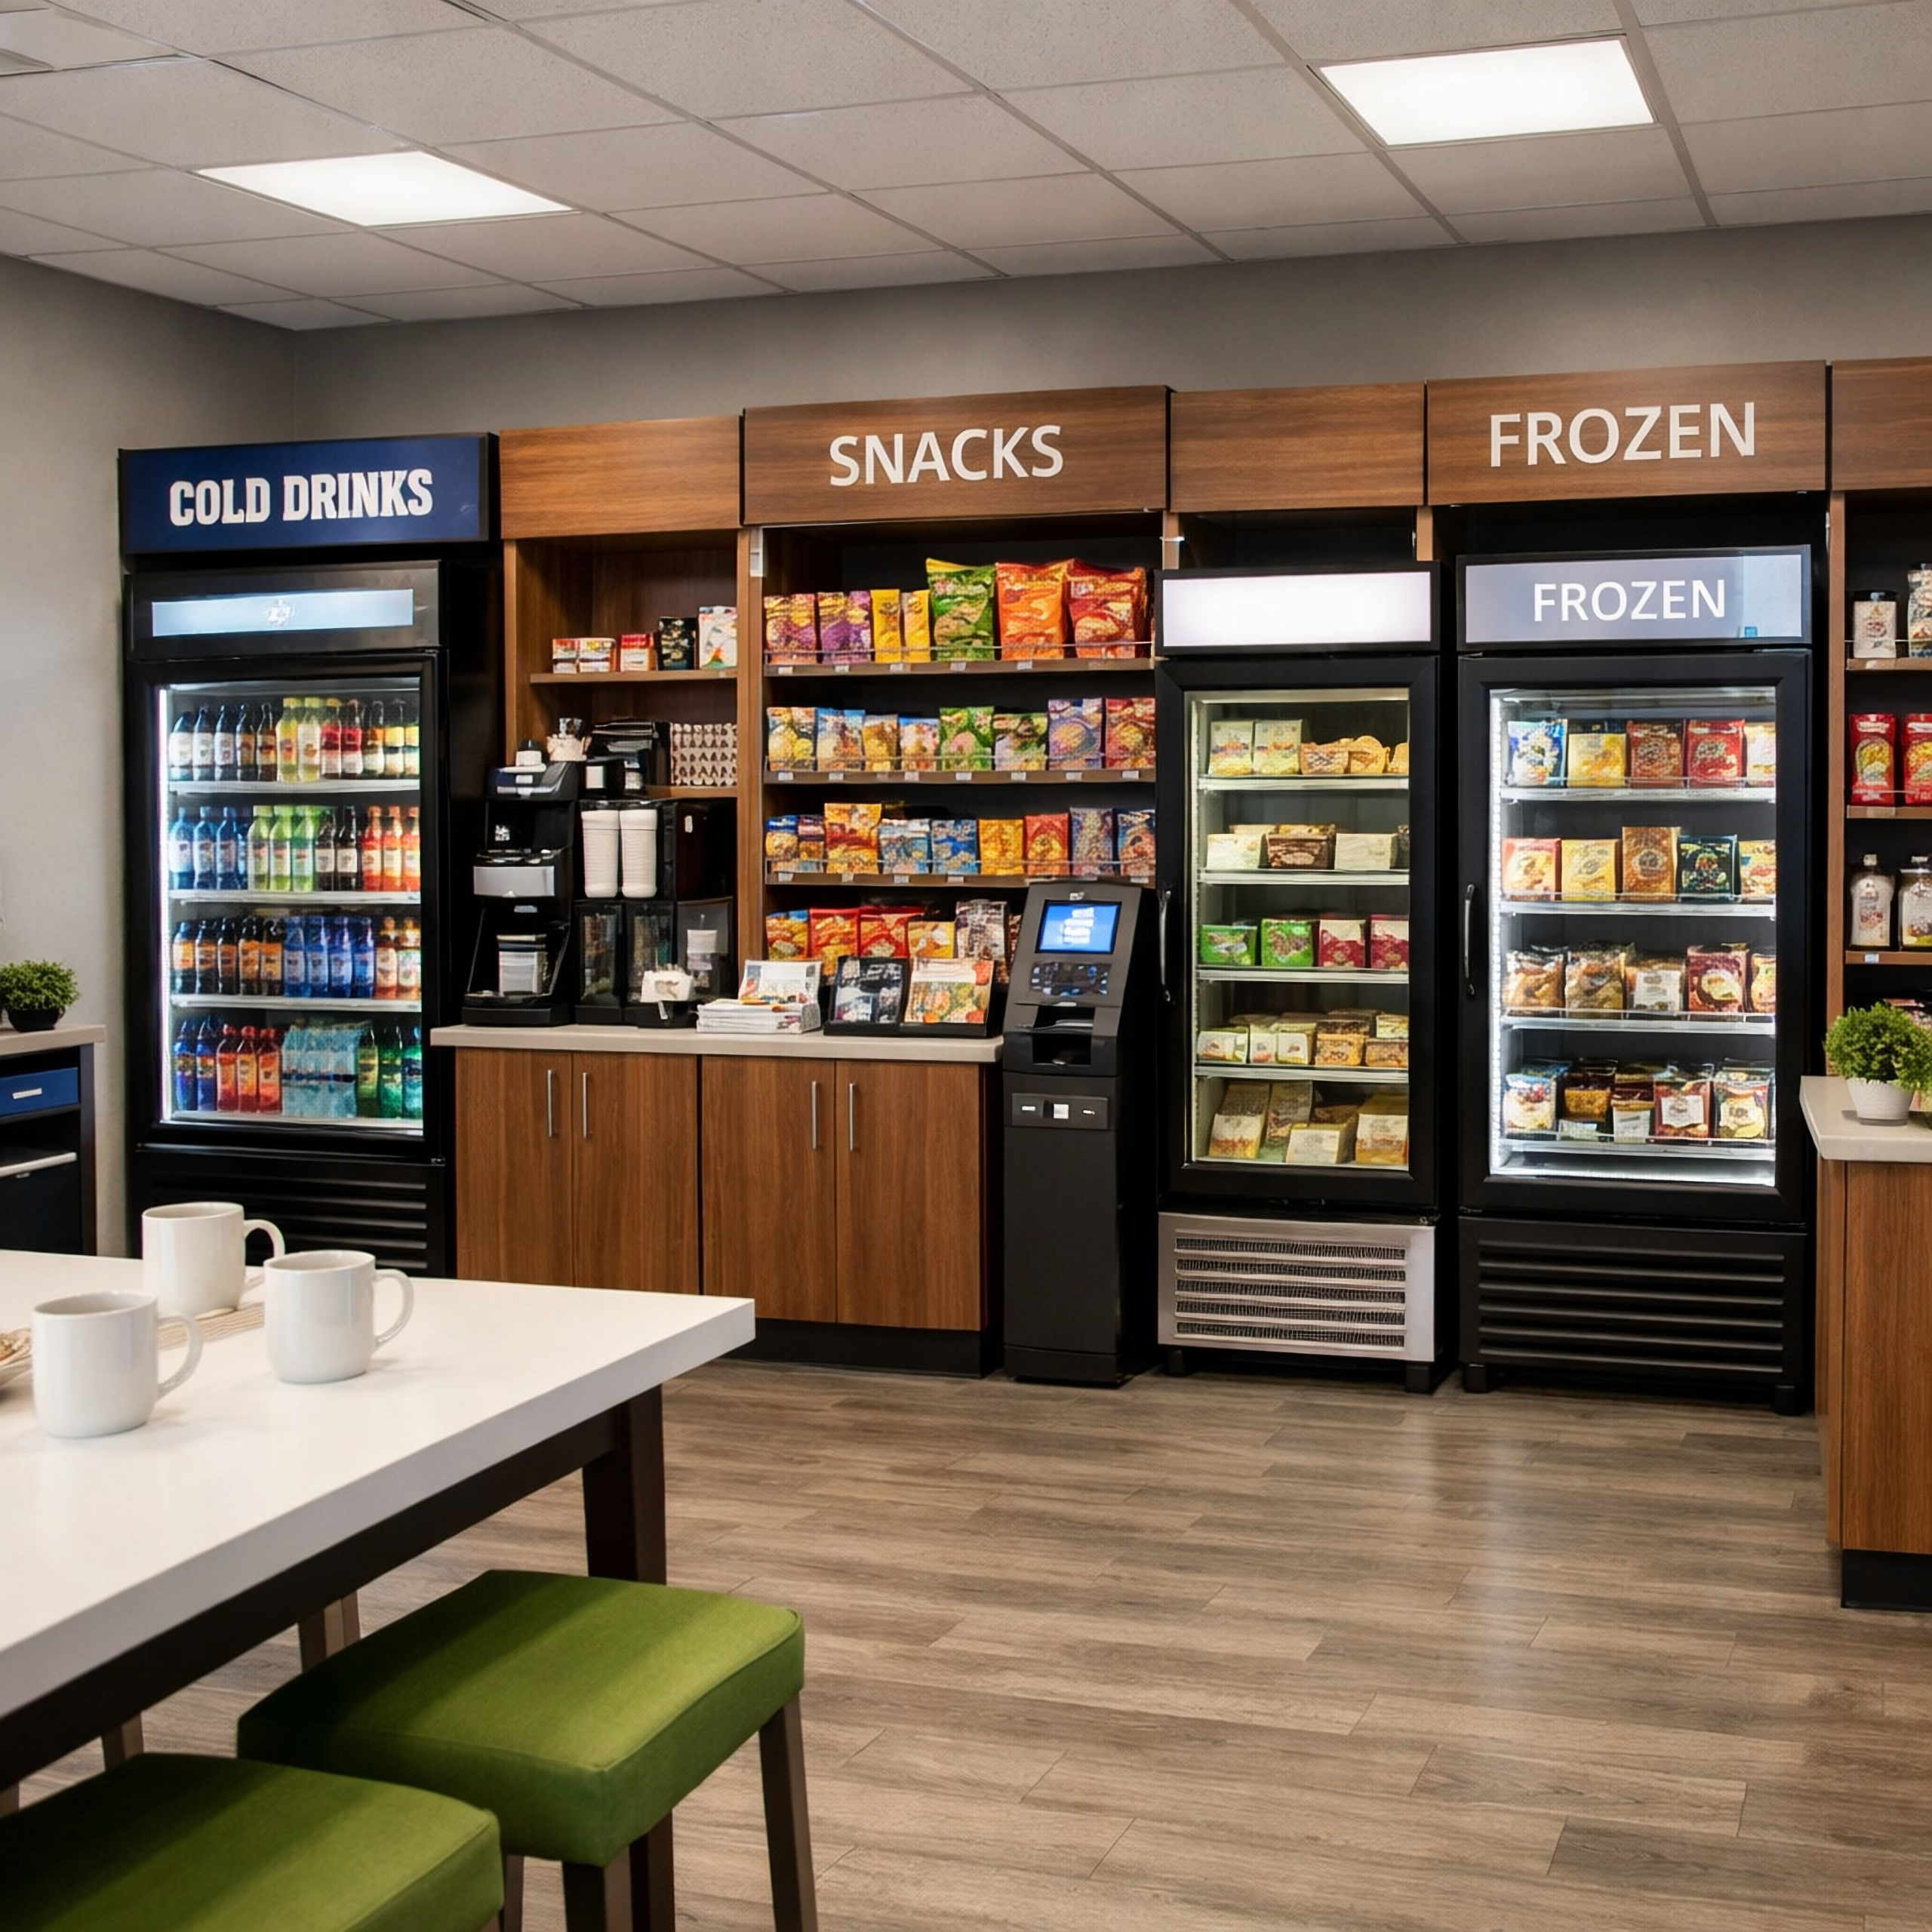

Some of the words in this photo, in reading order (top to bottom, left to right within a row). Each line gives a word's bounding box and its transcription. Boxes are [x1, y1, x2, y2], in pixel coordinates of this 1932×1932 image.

[829, 424, 1064, 487] SNACKS
[1490, 401, 1756, 468] FROZEN
[169, 477, 271, 527] COLD
[282, 468, 434, 521] DRINKS
[1534, 578, 1726, 622] FROZEN
